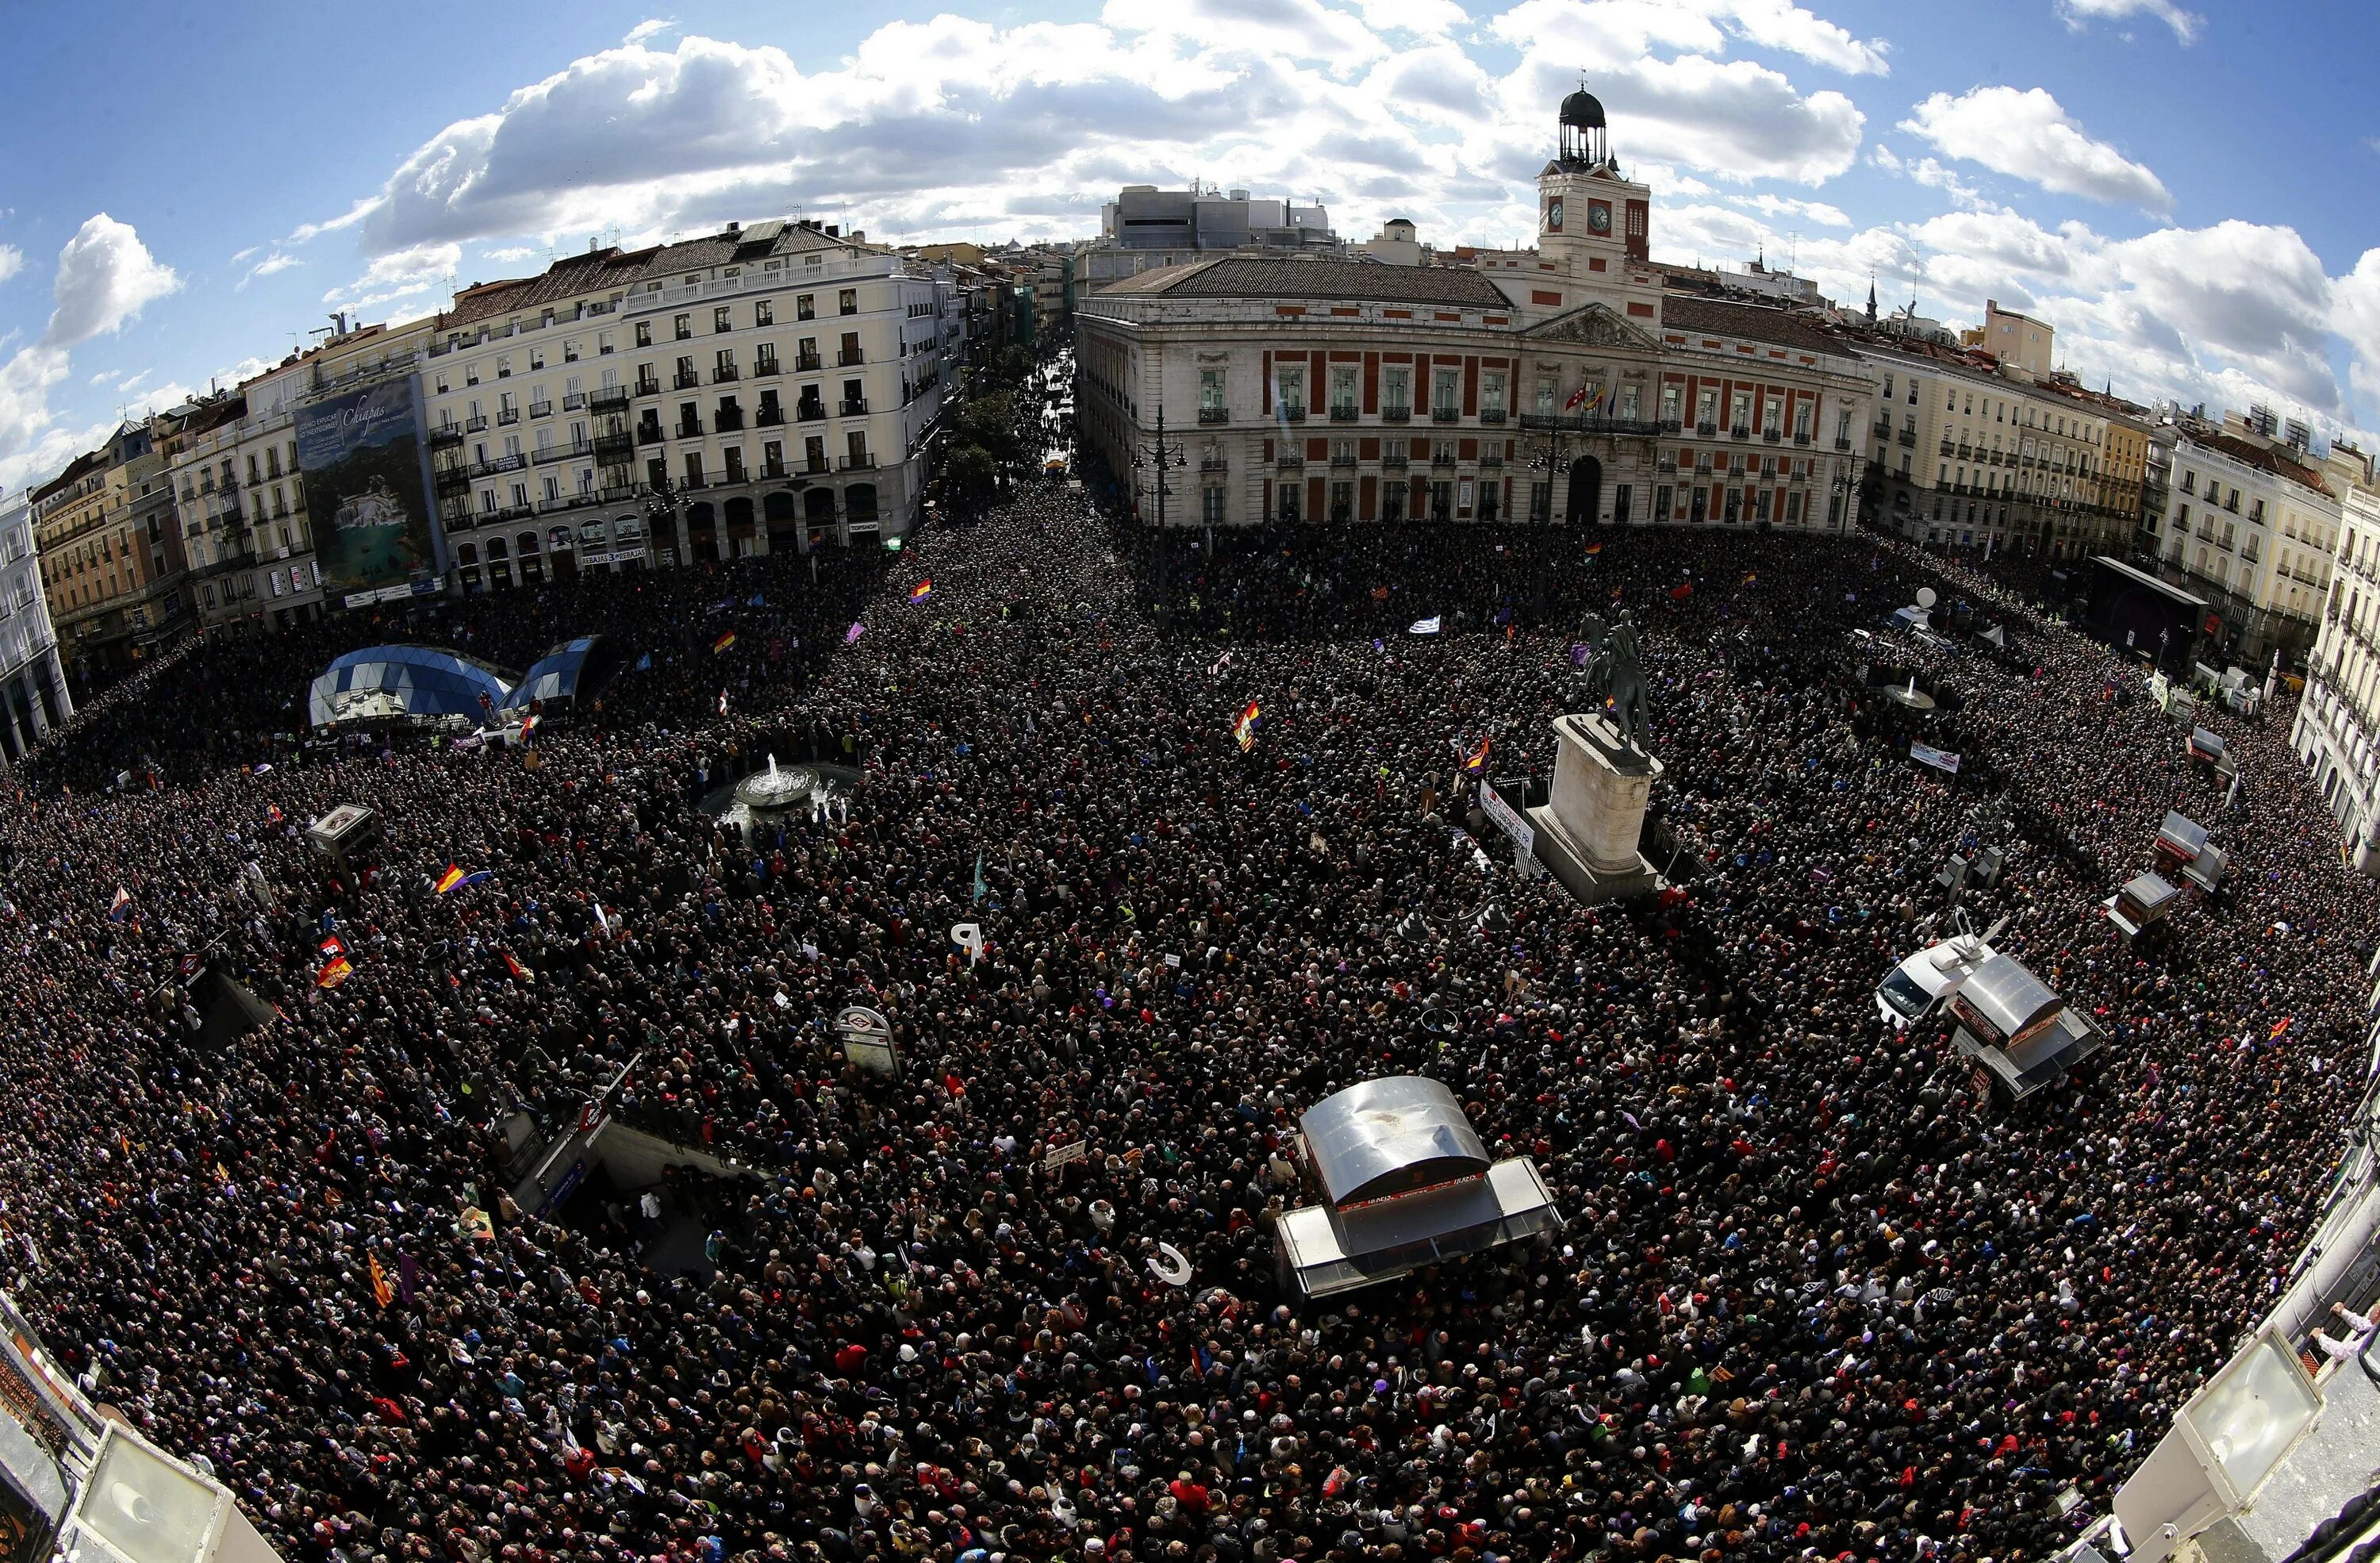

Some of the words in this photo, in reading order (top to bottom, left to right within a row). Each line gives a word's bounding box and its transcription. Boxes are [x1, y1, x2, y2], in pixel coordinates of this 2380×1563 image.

[343, 395, 385, 437] Chiapas
[582, 555, 608, 564] REBAJAS
[619, 548, 646, 559] REBAJAS
[455, 735, 480, 744] PODEMOS
[1522, 832, 1529, 844] PP
[587, 1108, 601, 1124] Metro
[1933, 1288, 1951, 1300] NO
